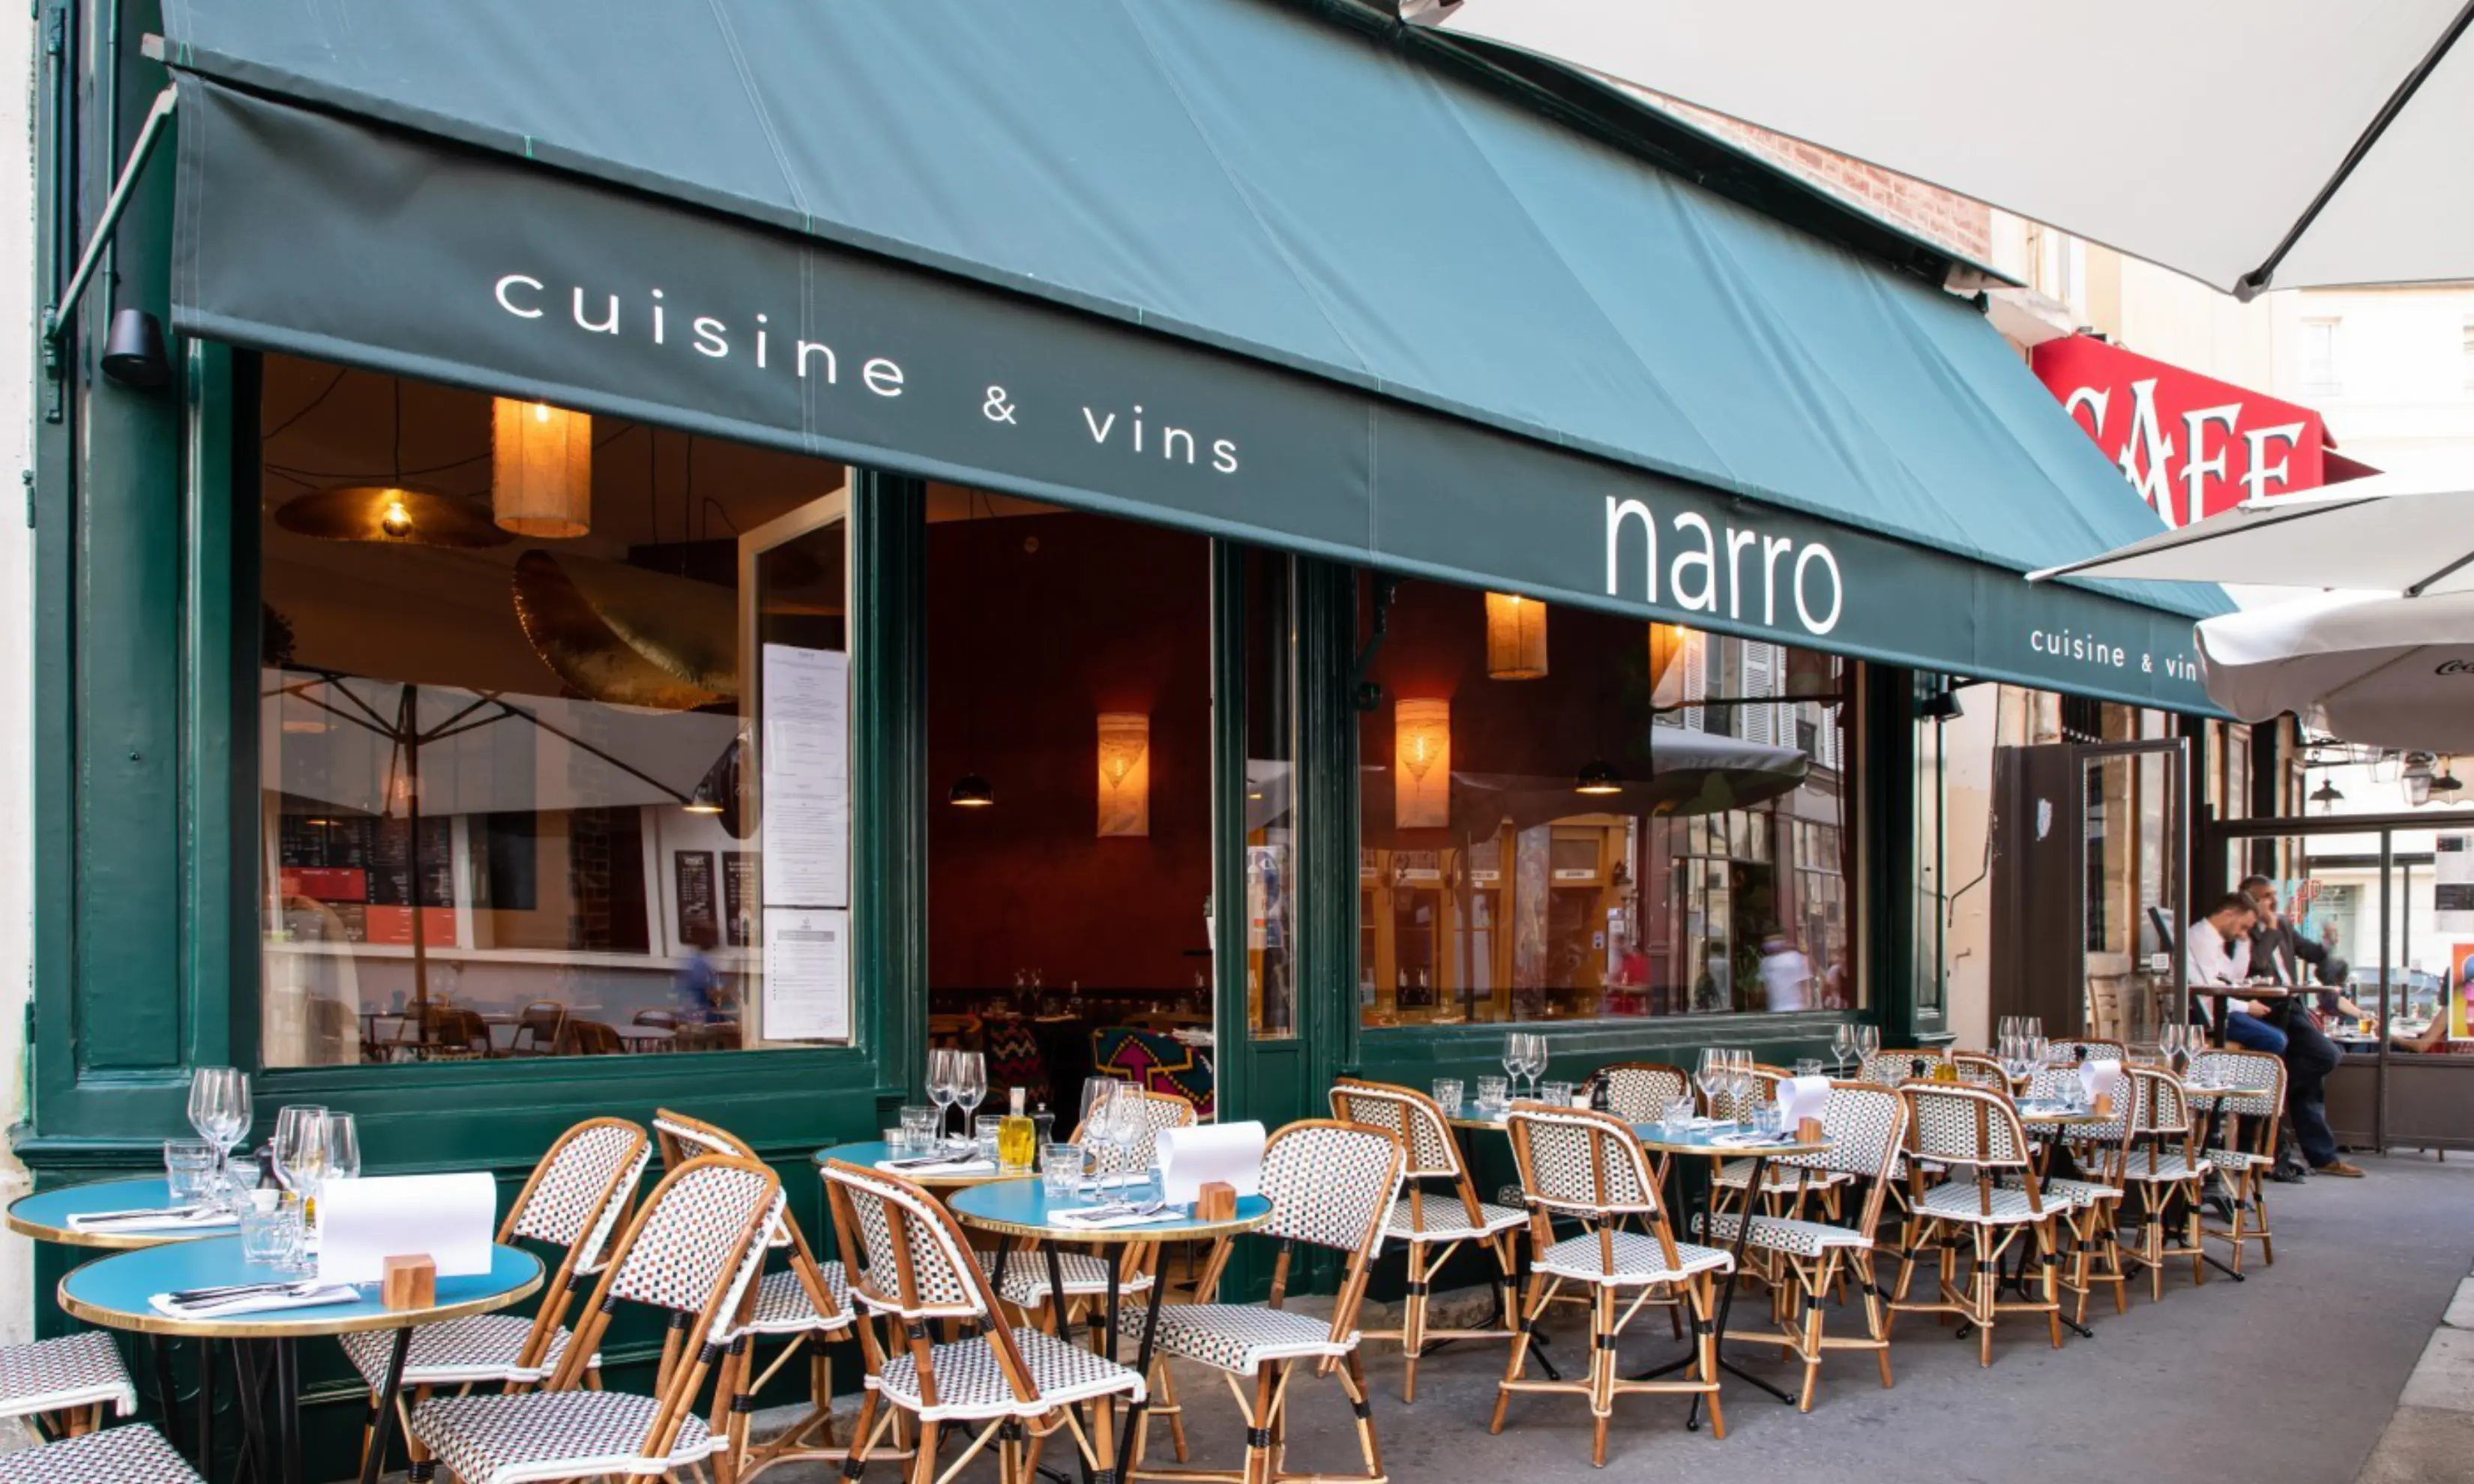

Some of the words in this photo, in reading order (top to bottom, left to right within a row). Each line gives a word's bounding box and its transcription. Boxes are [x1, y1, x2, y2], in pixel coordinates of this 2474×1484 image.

[495, 274, 905, 397] cuisine
[983, 385, 1017, 424] &
[1083, 405, 1238, 474] vins
[1606, 495, 1842, 635] narro
[2030, 628, 2126, 668] cuisine
[2141, 653, 2153, 674] &
[2165, 654, 2197, 682] vin
